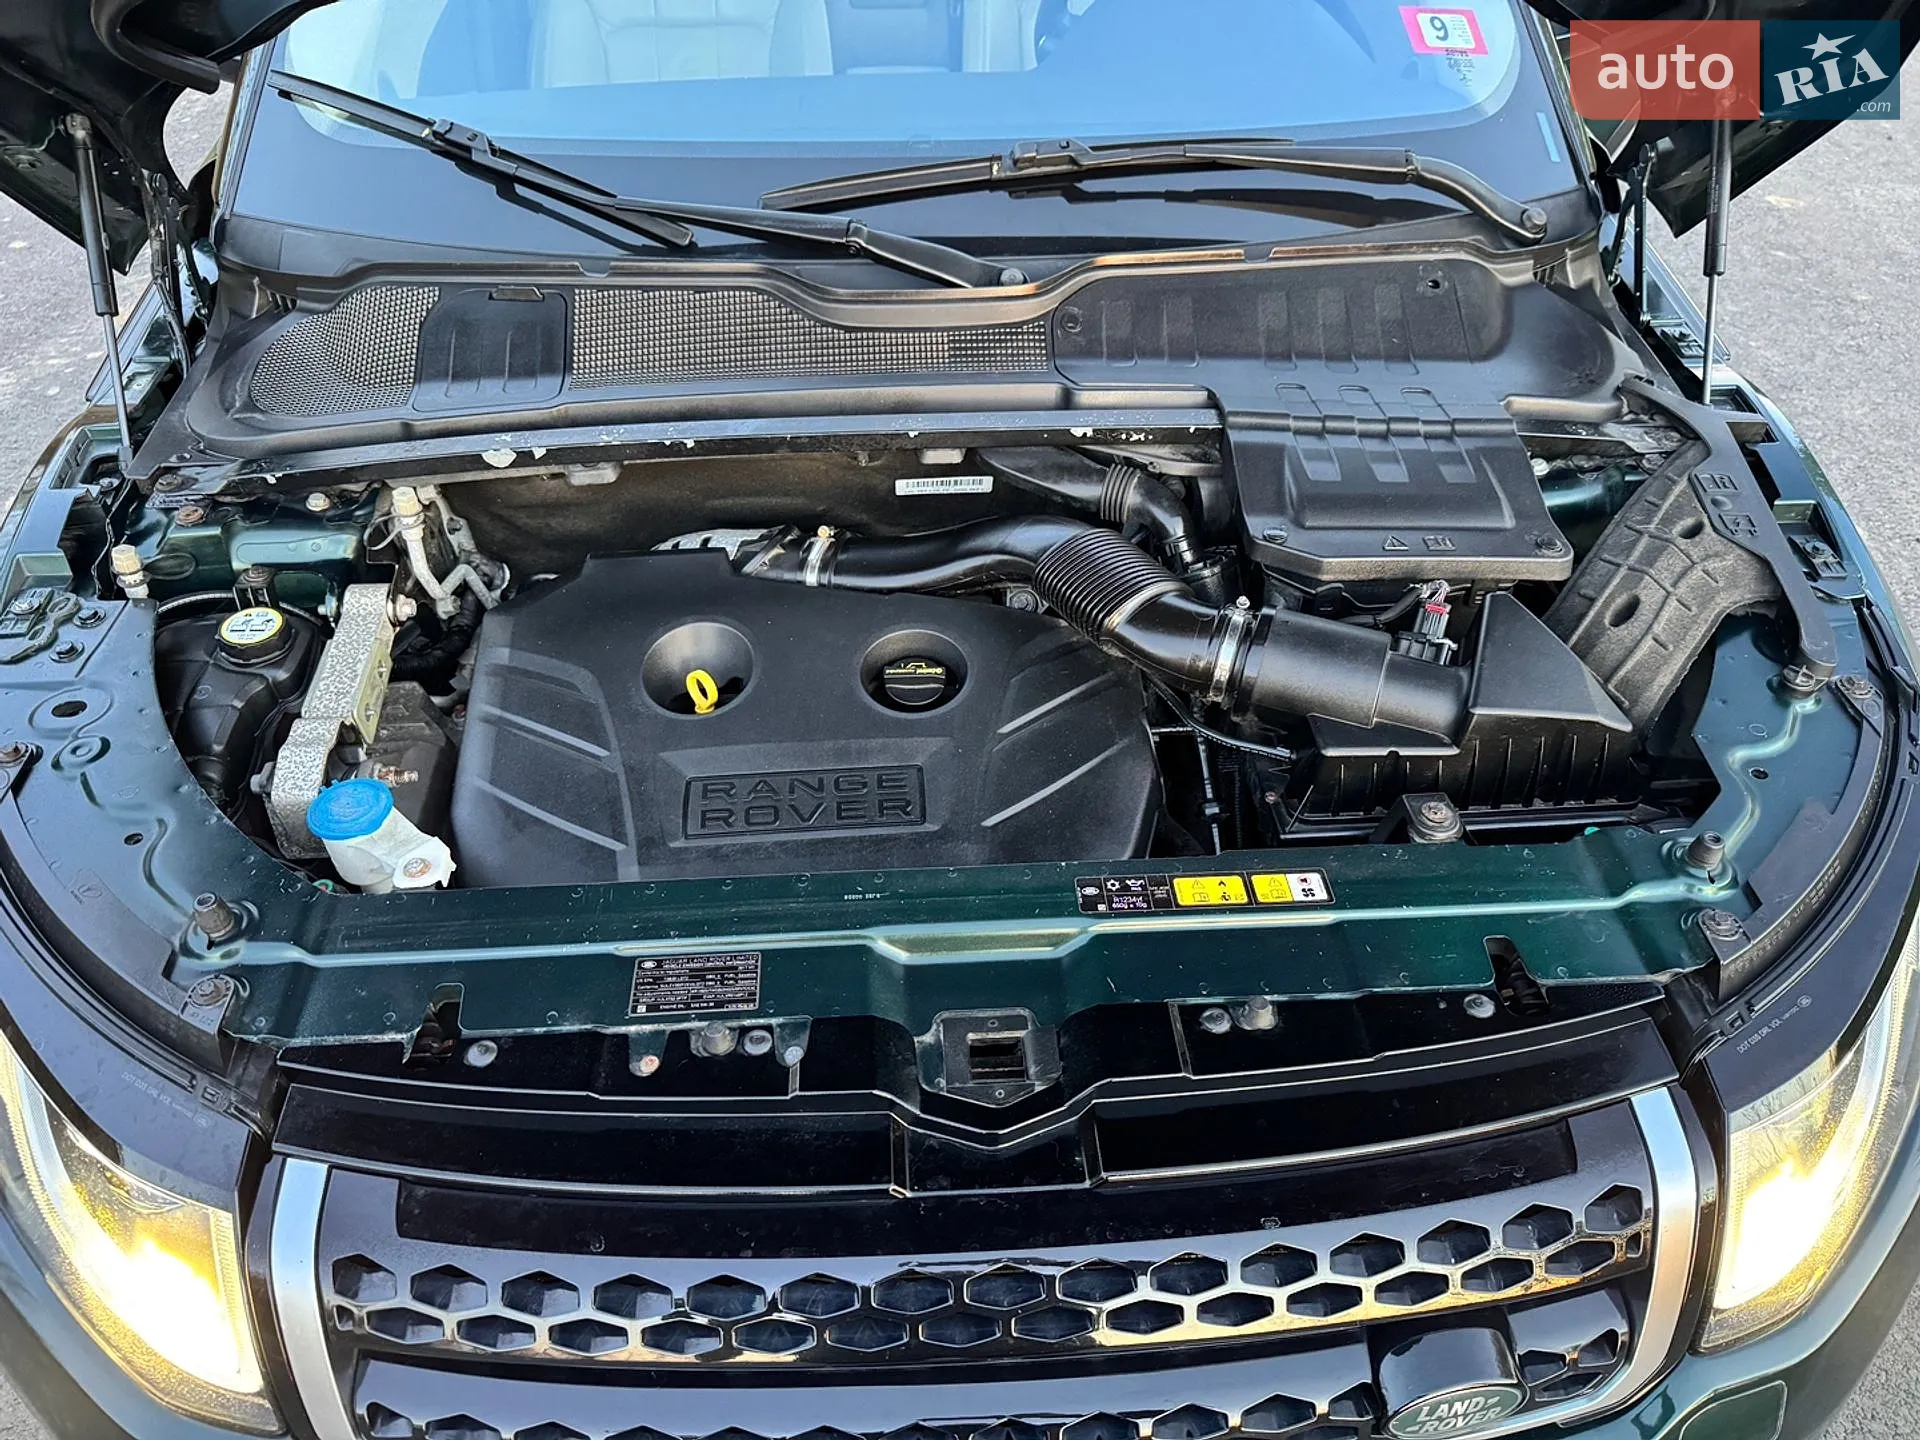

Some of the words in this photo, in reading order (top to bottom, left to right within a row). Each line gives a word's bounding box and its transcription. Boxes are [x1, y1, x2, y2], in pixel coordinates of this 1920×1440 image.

[701, 772, 909, 805] RANGE
[700, 797, 917, 831] ROVER
[1416, 1396, 1486, 1422] LAND
[1418, 1406, 1502, 1434] ROVER
